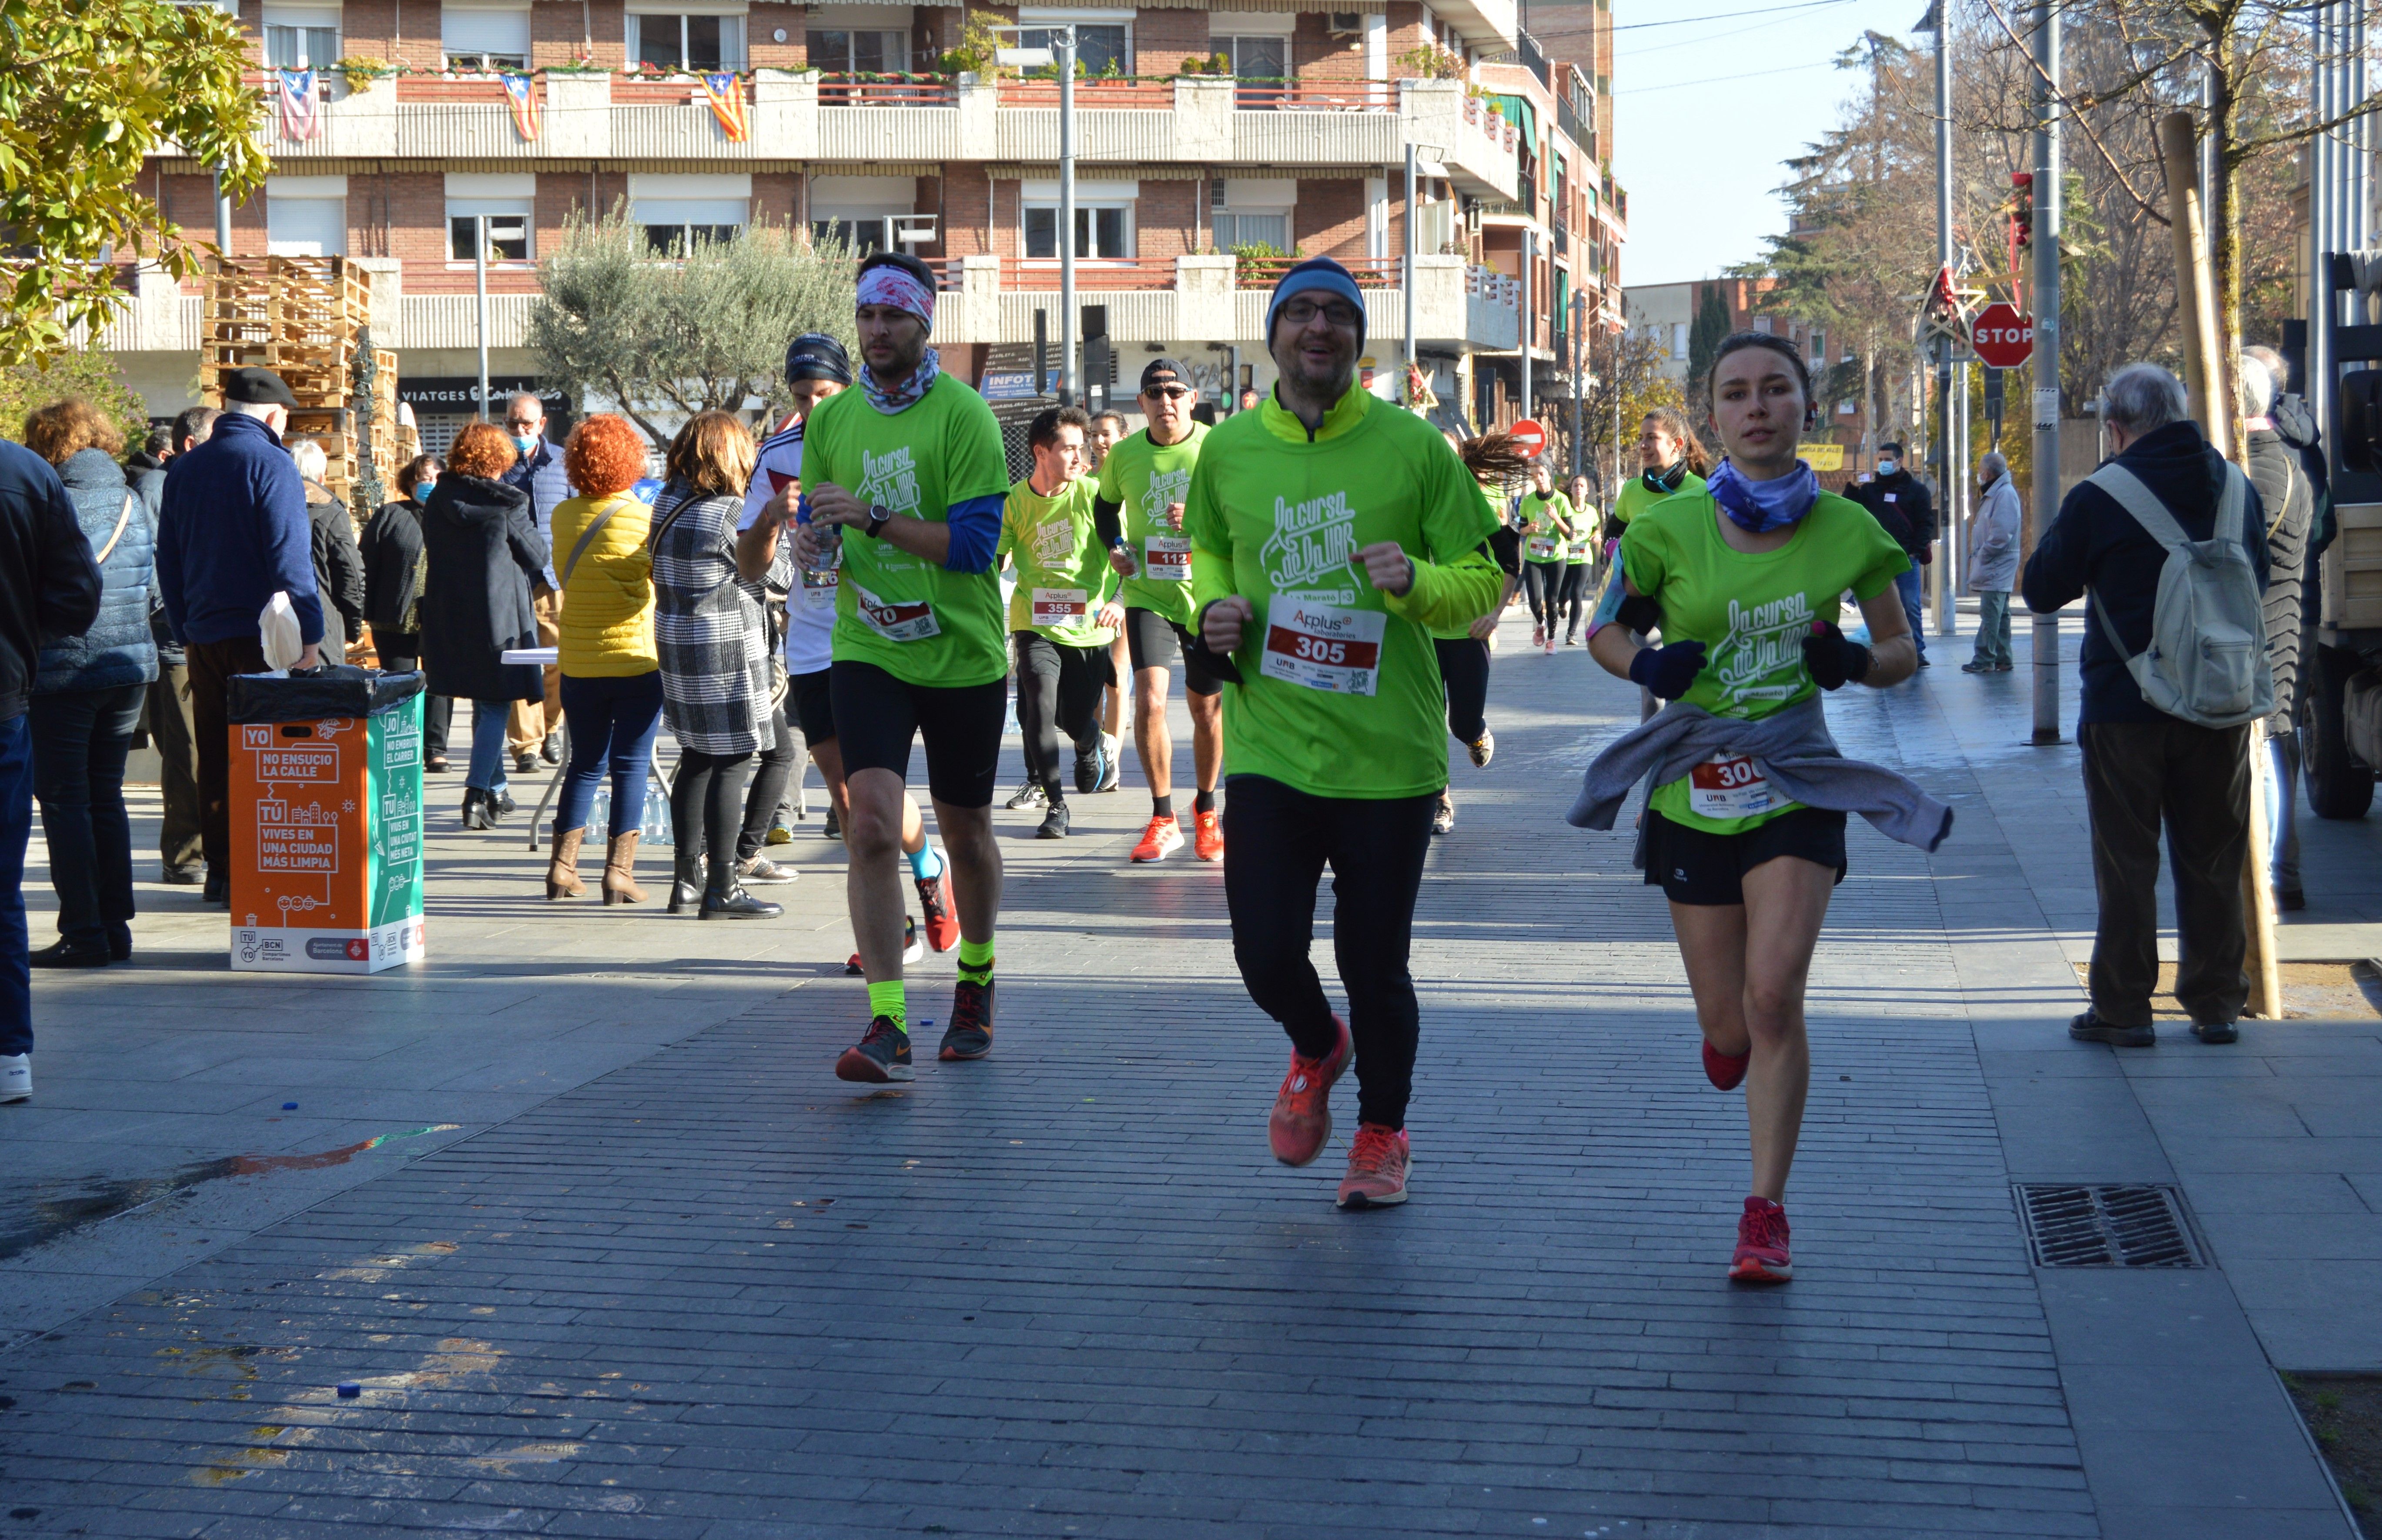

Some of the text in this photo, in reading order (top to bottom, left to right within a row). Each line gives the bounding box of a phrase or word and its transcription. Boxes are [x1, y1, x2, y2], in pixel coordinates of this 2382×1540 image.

[1976, 328, 2033, 344] STOP
[989, 375, 1034, 385] INFOT
[402, 391, 465, 401] VIATGES
[1298, 491, 1355, 528] cursa
[1162, 553, 1188, 564] 112
[1048, 603, 1071, 613] 355
[1753, 591, 1814, 629] cursa
[1314, 628, 1356, 639] laboratories
[1295, 636, 1346, 664] 305
[386, 718, 396, 732] JO
[247, 730, 268, 744] YO
[387, 737, 418, 751] NO EMBRUTO
[263, 754, 332, 765] NO ENSUCIO
[387, 750, 414, 763] EL CARRER
[263, 766, 317, 777] LA CALLE
[1706, 794, 1726, 802] UAB
[261, 802, 281, 821] TÚ
[385, 800, 393, 815] TU
[390, 819, 409, 833] VIUS EN
[262, 828, 314, 840] VIVES EN
[390, 831, 417, 847] UNA CIUTAT
[263, 842, 332, 854] UNA CIUDAD
[390, 845, 413, 861] MÉS NETA
[263, 853, 331, 868] MÁS LIMPIA
[243, 933, 253, 941] TÚ
